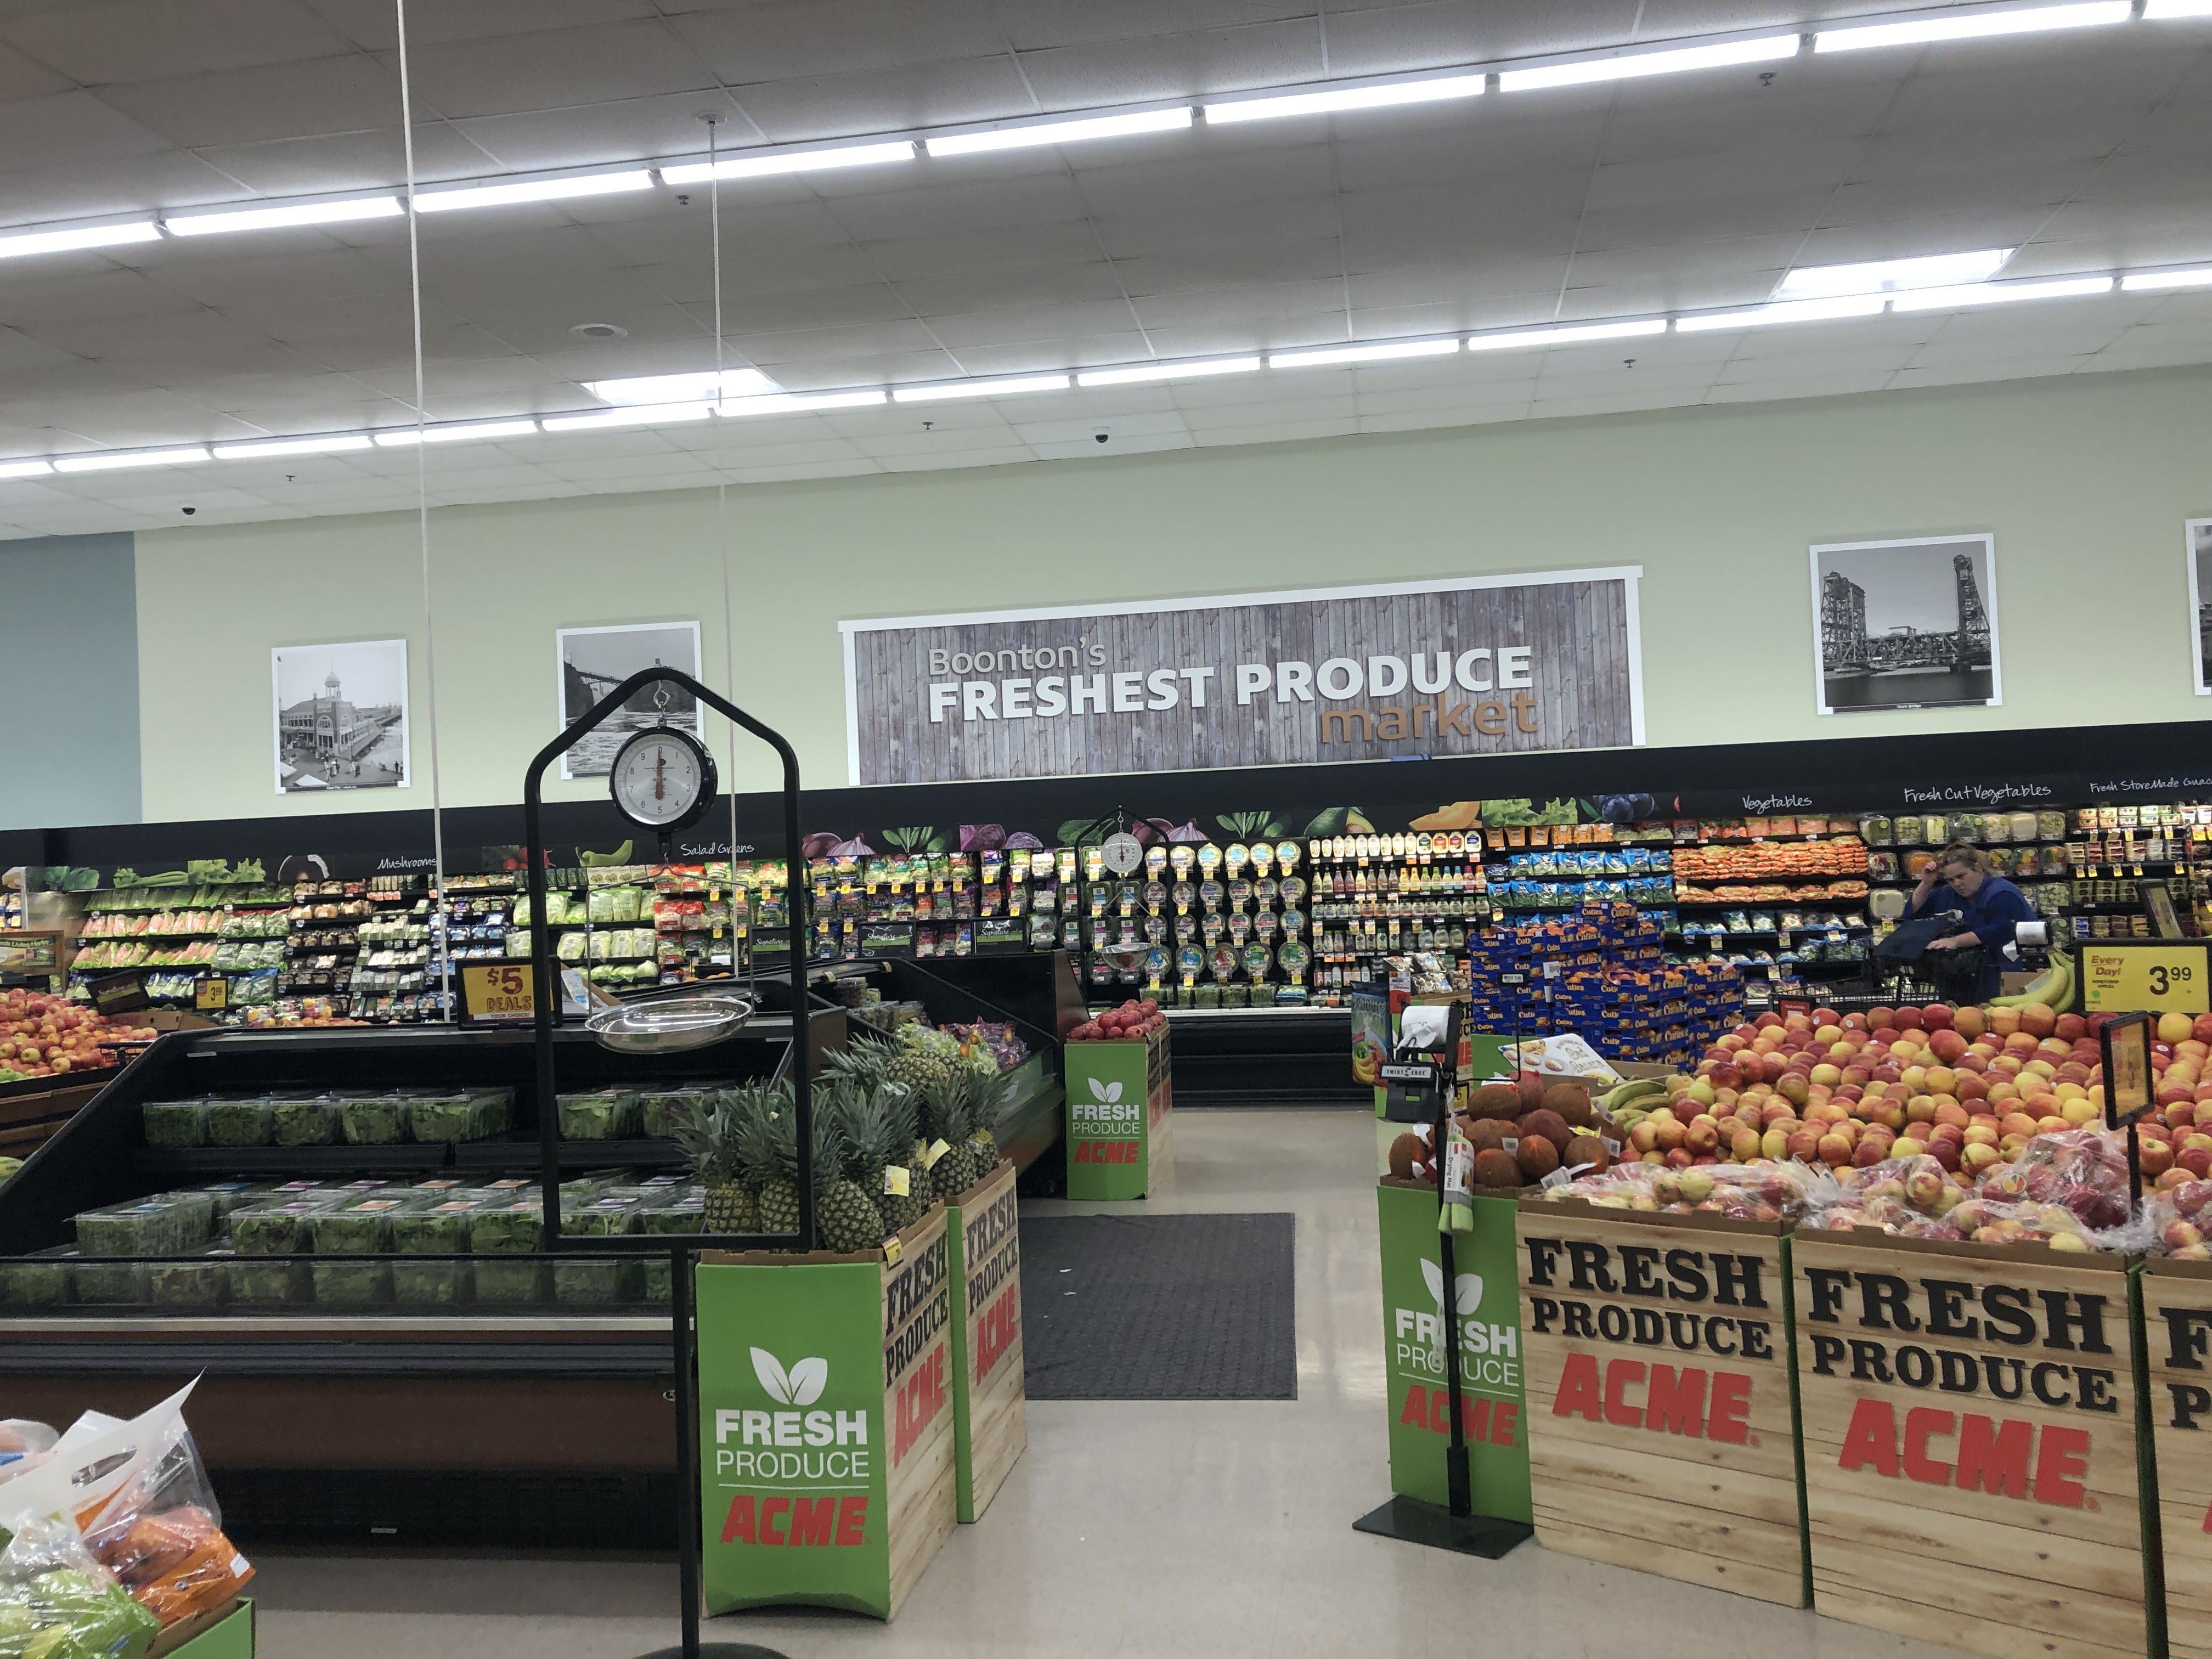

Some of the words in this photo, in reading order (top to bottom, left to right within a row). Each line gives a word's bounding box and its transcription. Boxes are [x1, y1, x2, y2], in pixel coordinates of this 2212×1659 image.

[929, 636, 1106, 677] Boonton's
[929, 666, 1214, 723] FRESHEST
[1237, 646, 1534, 706] PRODUCE
[1321, 690, 1538, 744] market
[1904, 787, 1943, 803] Fresh
[1945, 785, 1973, 800] Cut
[1973, 783, 2052, 804] Vegetables
[2090, 781, 2118, 793] Fresh
[1742, 794, 1813, 815] Vegetables
[376, 855, 437, 870] Mushrooms
[680, 842, 715, 856] Salad
[718, 843, 754, 854] Grens
[1582, 908, 1603, 916] Cuties
[755, 937, 784, 947] Signature
[866, 933, 896, 941] Signature
[981, 928, 1009, 936] Signature
[2091, 955, 2125, 966] Every
[2096, 967, 2121, 977] Day!
[487, 967, 523, 995] $5
[1601, 985, 1618, 993] Cuti
[486, 995, 532, 1013] DEALS
[1601, 1011, 1620, 1019] Cuti
[1601, 1036, 1620, 1045] Cuti
[1072, 1104, 1139, 1120] FRESH
[1073, 1122, 1140, 1134] PRODUCE
[1073, 1141, 1139, 1164] ACME
[966, 1185, 1016, 1271] FRESH
[885, 1229, 947, 1338] FRESH
[969, 1235, 1018, 1317] PRODUCE
[1524, 1237, 1769, 1310] FRESH
[1804, 1267, 2113, 1355] FRESH
[885, 1287, 949, 1388] PRODUCE
[976, 1284, 1017, 1386] ACME
[1530, 1296, 1774, 1361] PRODUCE
[1397, 1342, 1520, 1387] PROUCE
[1809, 1334, 2119, 1414] PRODUCE
[894, 1342, 945, 1469] ACME
[1552, 1352, 1752, 1445] ACME
[715, 1409, 867, 1447] FRESH
[1400, 1384, 1519, 1447] ACME
[716, 1450, 870, 1479] PRODUCE
[1838, 1398, 2091, 1508] ACME
[719, 1494, 868, 1547] ACME
